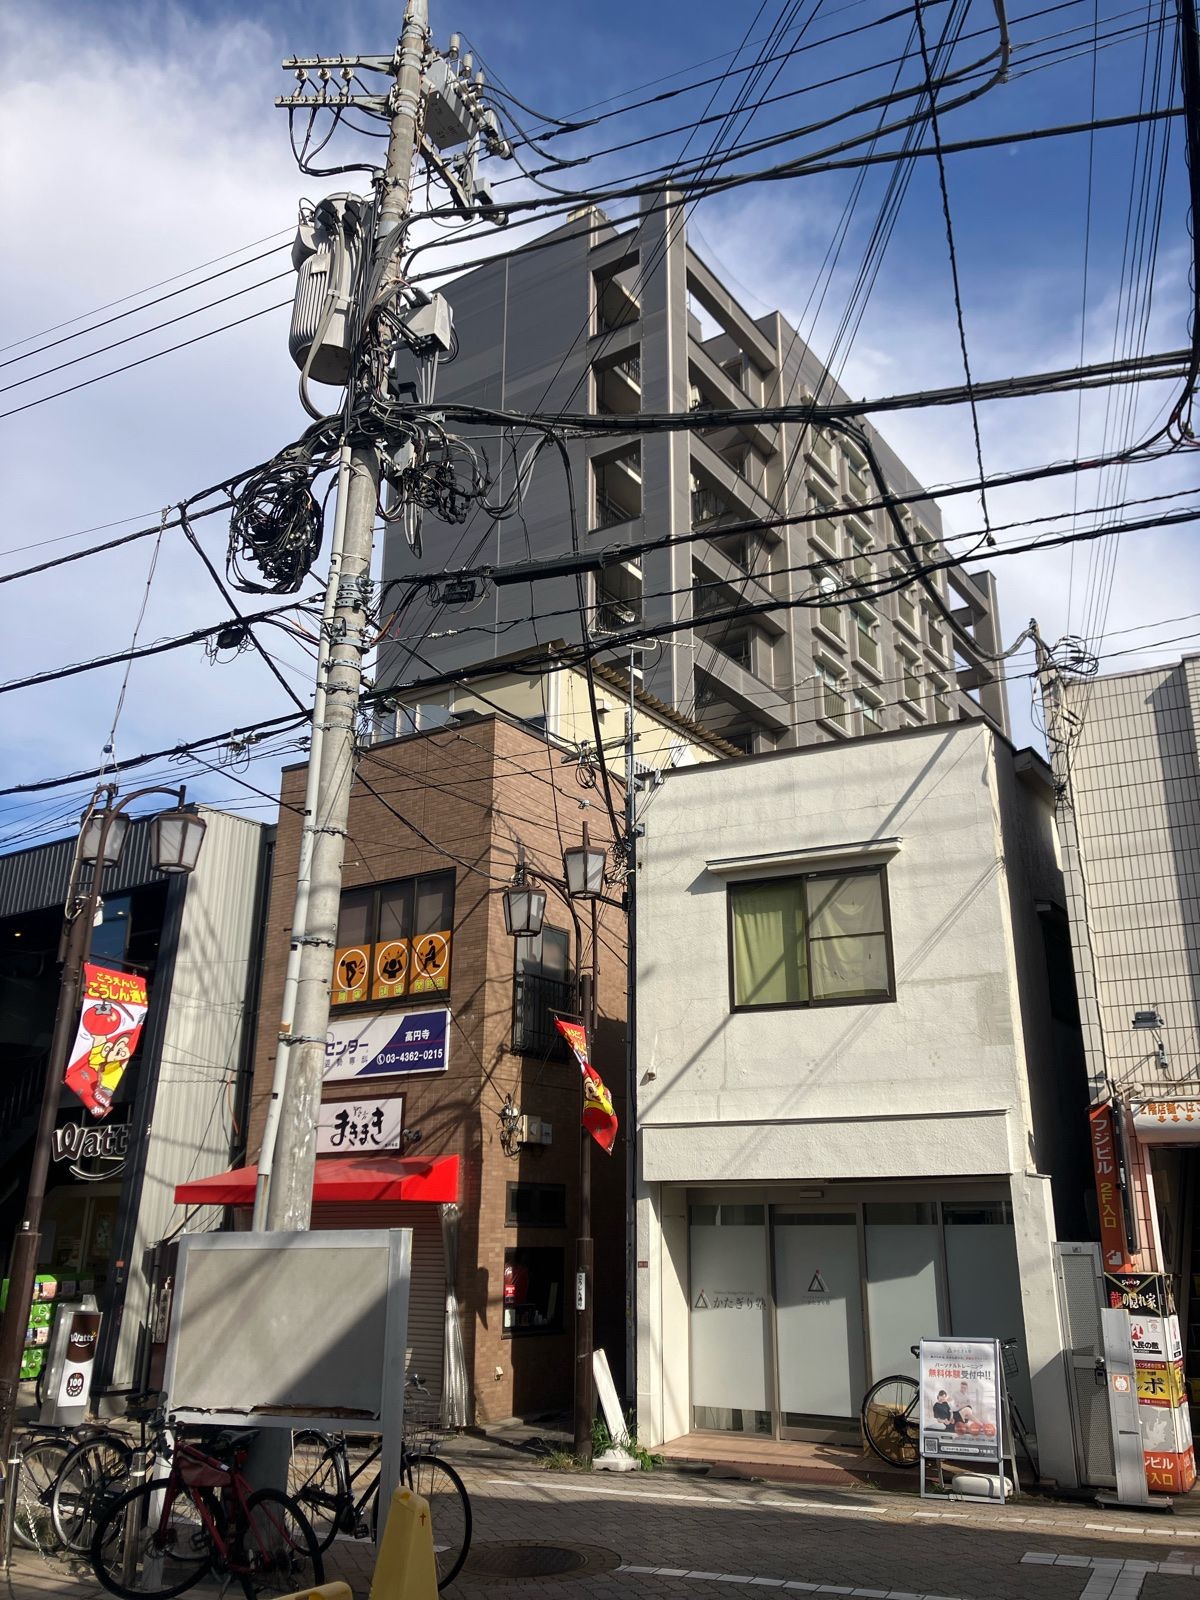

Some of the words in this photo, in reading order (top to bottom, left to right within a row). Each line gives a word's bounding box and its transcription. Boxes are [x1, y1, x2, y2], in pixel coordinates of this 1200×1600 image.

[97, 972, 138, 989] こうえんじ
[88, 982, 148, 1004] こうしん通り
[404, 1029, 431, 1042] 高円寺
[325, 1039, 369, 1056] センター
[386, 1049, 443, 1064] 03-4362-0215
[330, 1106, 385, 1147] まきまき
[51, 1121, 130, 1163] Watt
[1092, 1119, 1113, 1175] フジビル
[1100, 1182, 1117, 1229] 2F入口
[69, 1378, 82, 1387] 100
[928, 1368, 992, 1380] 無料体験受付中!!
[1147, 1472, 1173, 1486] 入口
